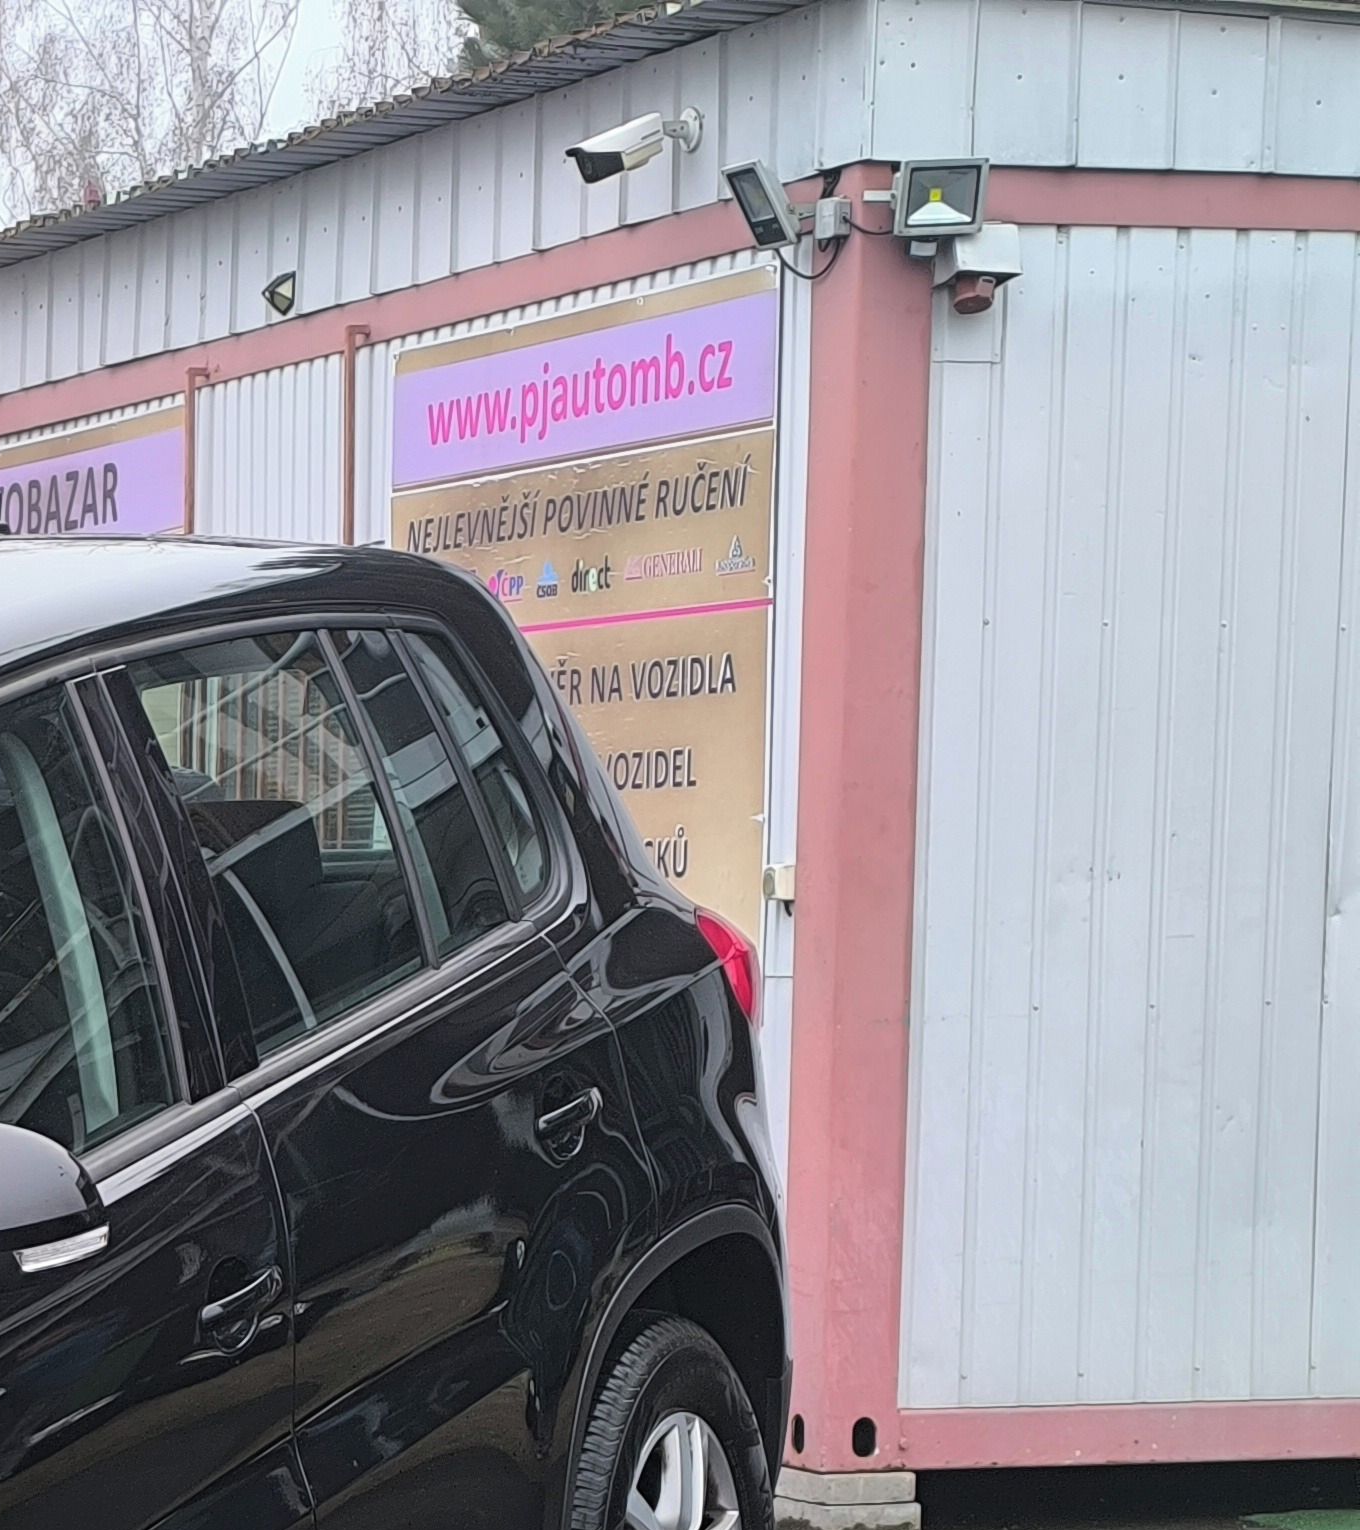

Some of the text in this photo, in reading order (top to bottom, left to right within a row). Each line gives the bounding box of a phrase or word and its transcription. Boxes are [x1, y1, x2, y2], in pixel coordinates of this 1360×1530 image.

[427, 334, 734, 445] www.pjautomb.cz
[407, 452, 752, 554] NEJLEVNĚJŠÍ POVINNÉ RUČENÍ
[572, 555, 611, 593] direct
[643, 547, 703, 578] GENERALI
[550, 652, 737, 706] ĚR NA VOZIDLA
[644, 825, 689, 879] KŮ
